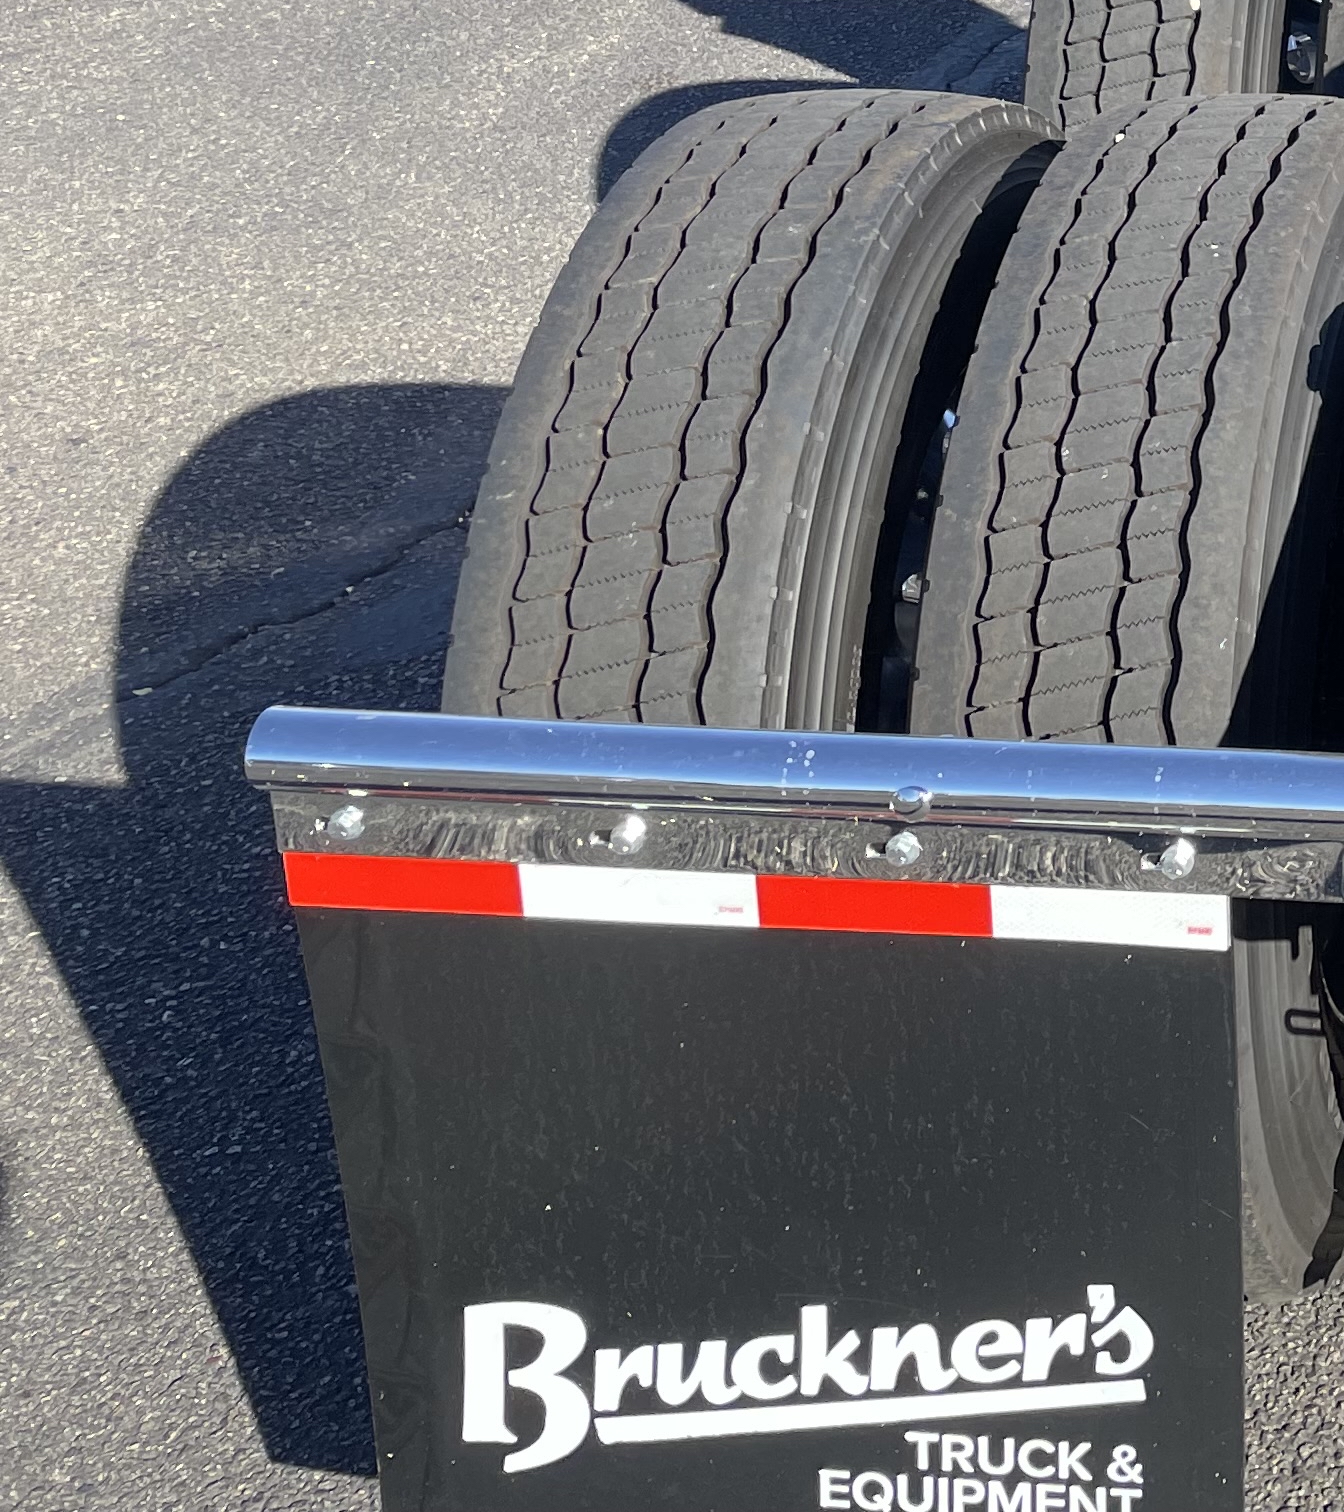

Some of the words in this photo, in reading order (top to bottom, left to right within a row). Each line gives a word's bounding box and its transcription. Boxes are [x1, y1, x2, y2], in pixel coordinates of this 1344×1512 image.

[461, 1284, 1155, 1474] Bruckner's
[904, 1430, 1093, 1482] TRUCK
[1106, 1444, 1144, 1484] &
[818, 1468, 1143, 1512] EQUIPMENT
